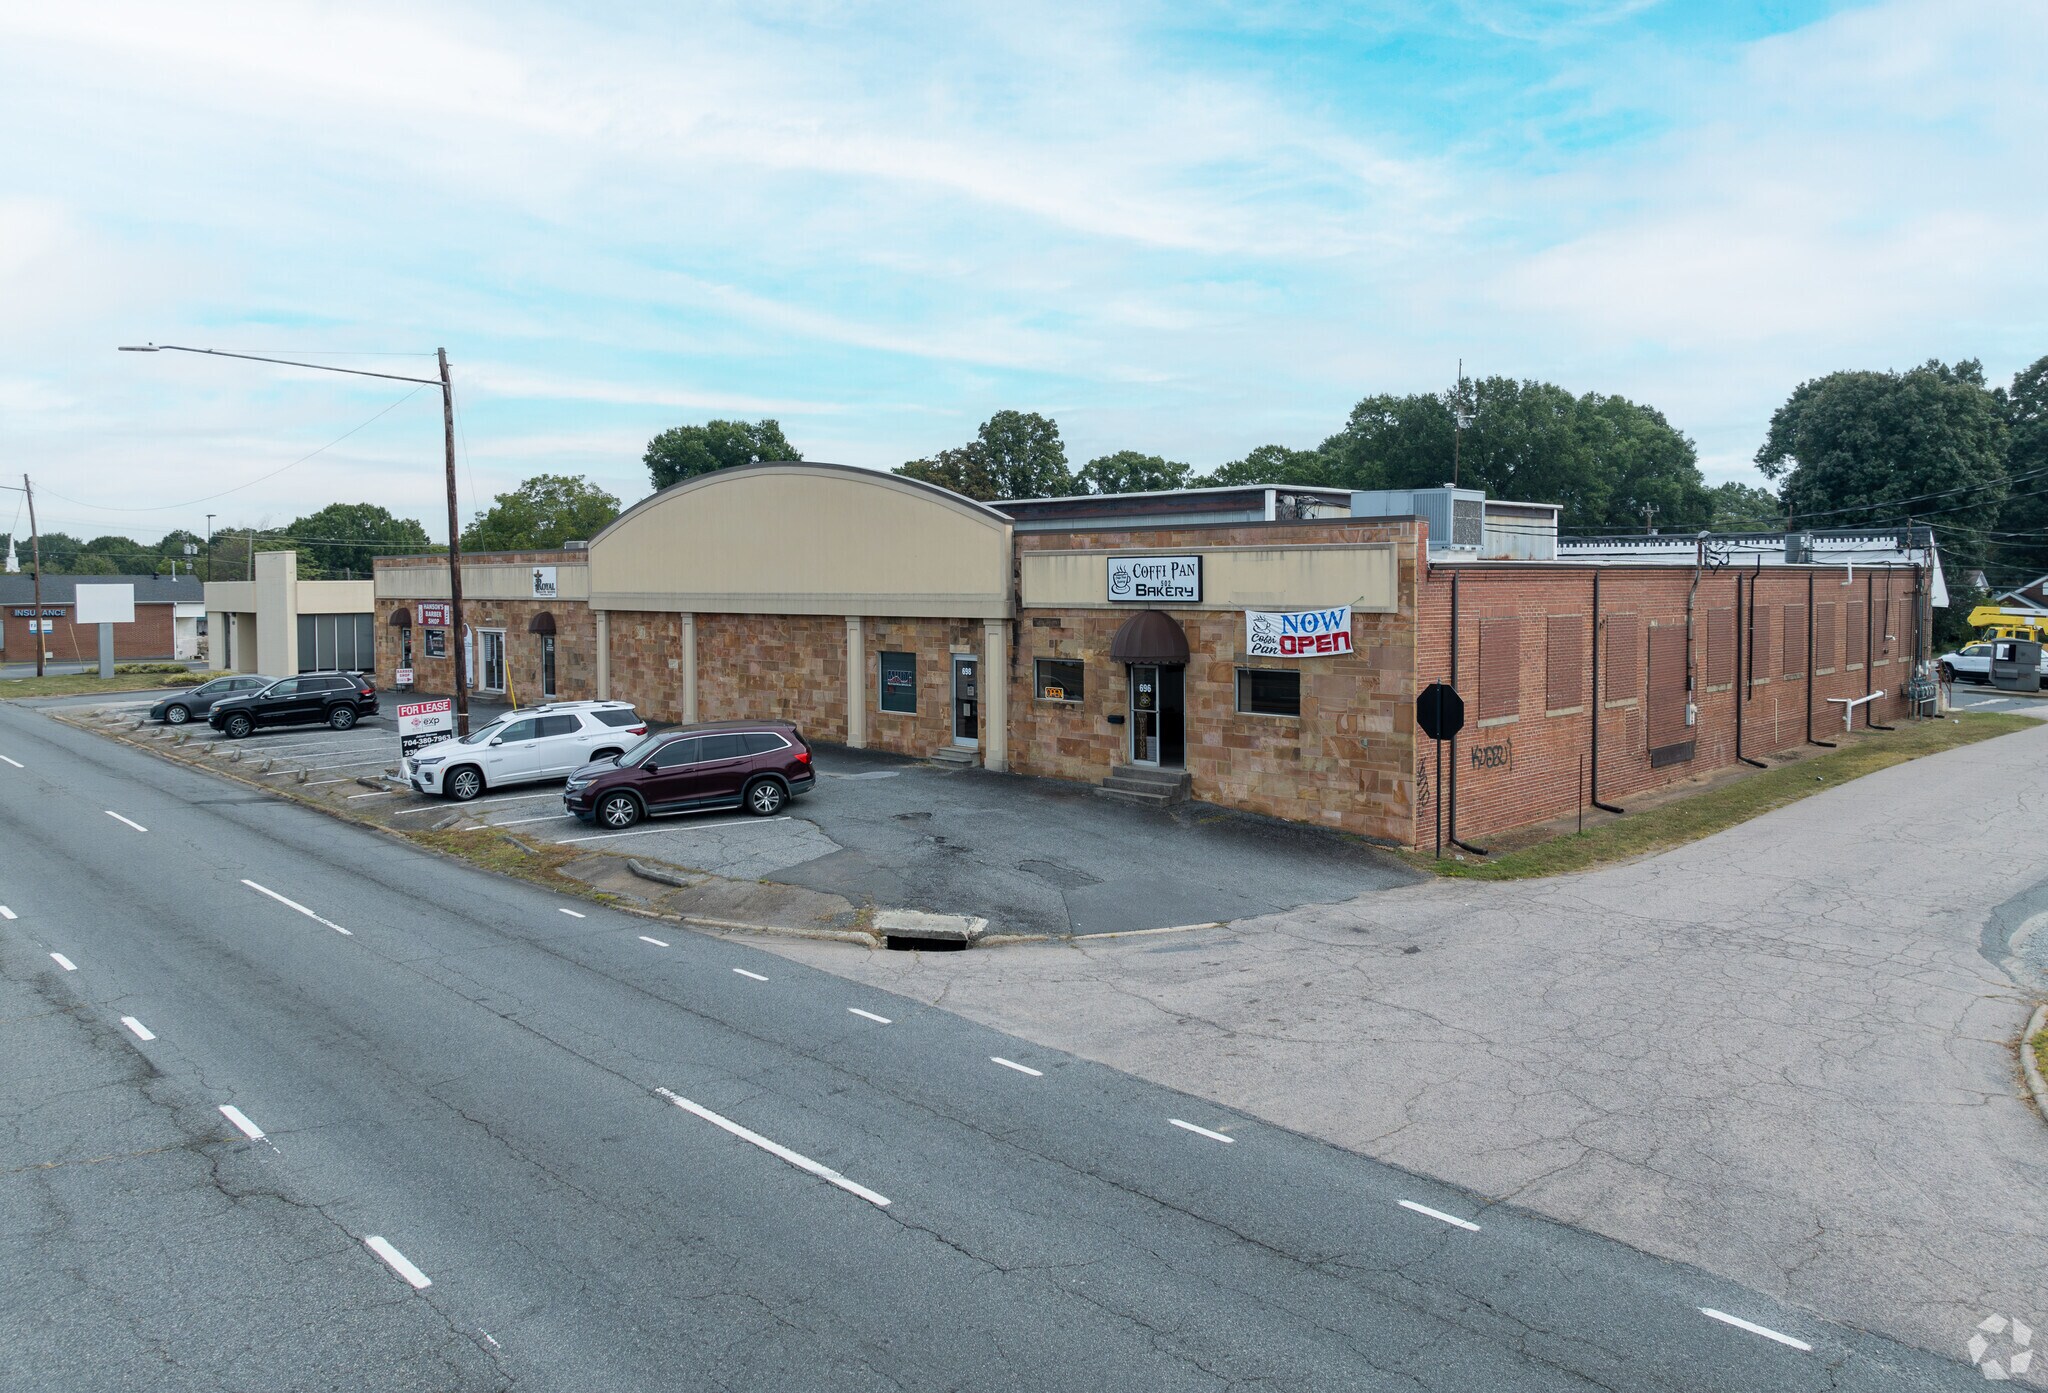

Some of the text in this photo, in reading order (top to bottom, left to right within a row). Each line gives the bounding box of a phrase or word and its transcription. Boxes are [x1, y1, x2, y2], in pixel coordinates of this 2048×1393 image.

[14, 609, 66, 617] INSUANCE
[425, 610, 443, 618] BARBER
[1281, 609, 1346, 634] NOW
[1251, 633, 1277, 644] Coffi
[1279, 631, 1351, 655] OPEN
[1251, 643, 1279, 655] Pan
[961, 667, 972, 676] 698
[1139, 683, 1152, 693] 696
[401, 701, 448, 716] FOR LEASE
